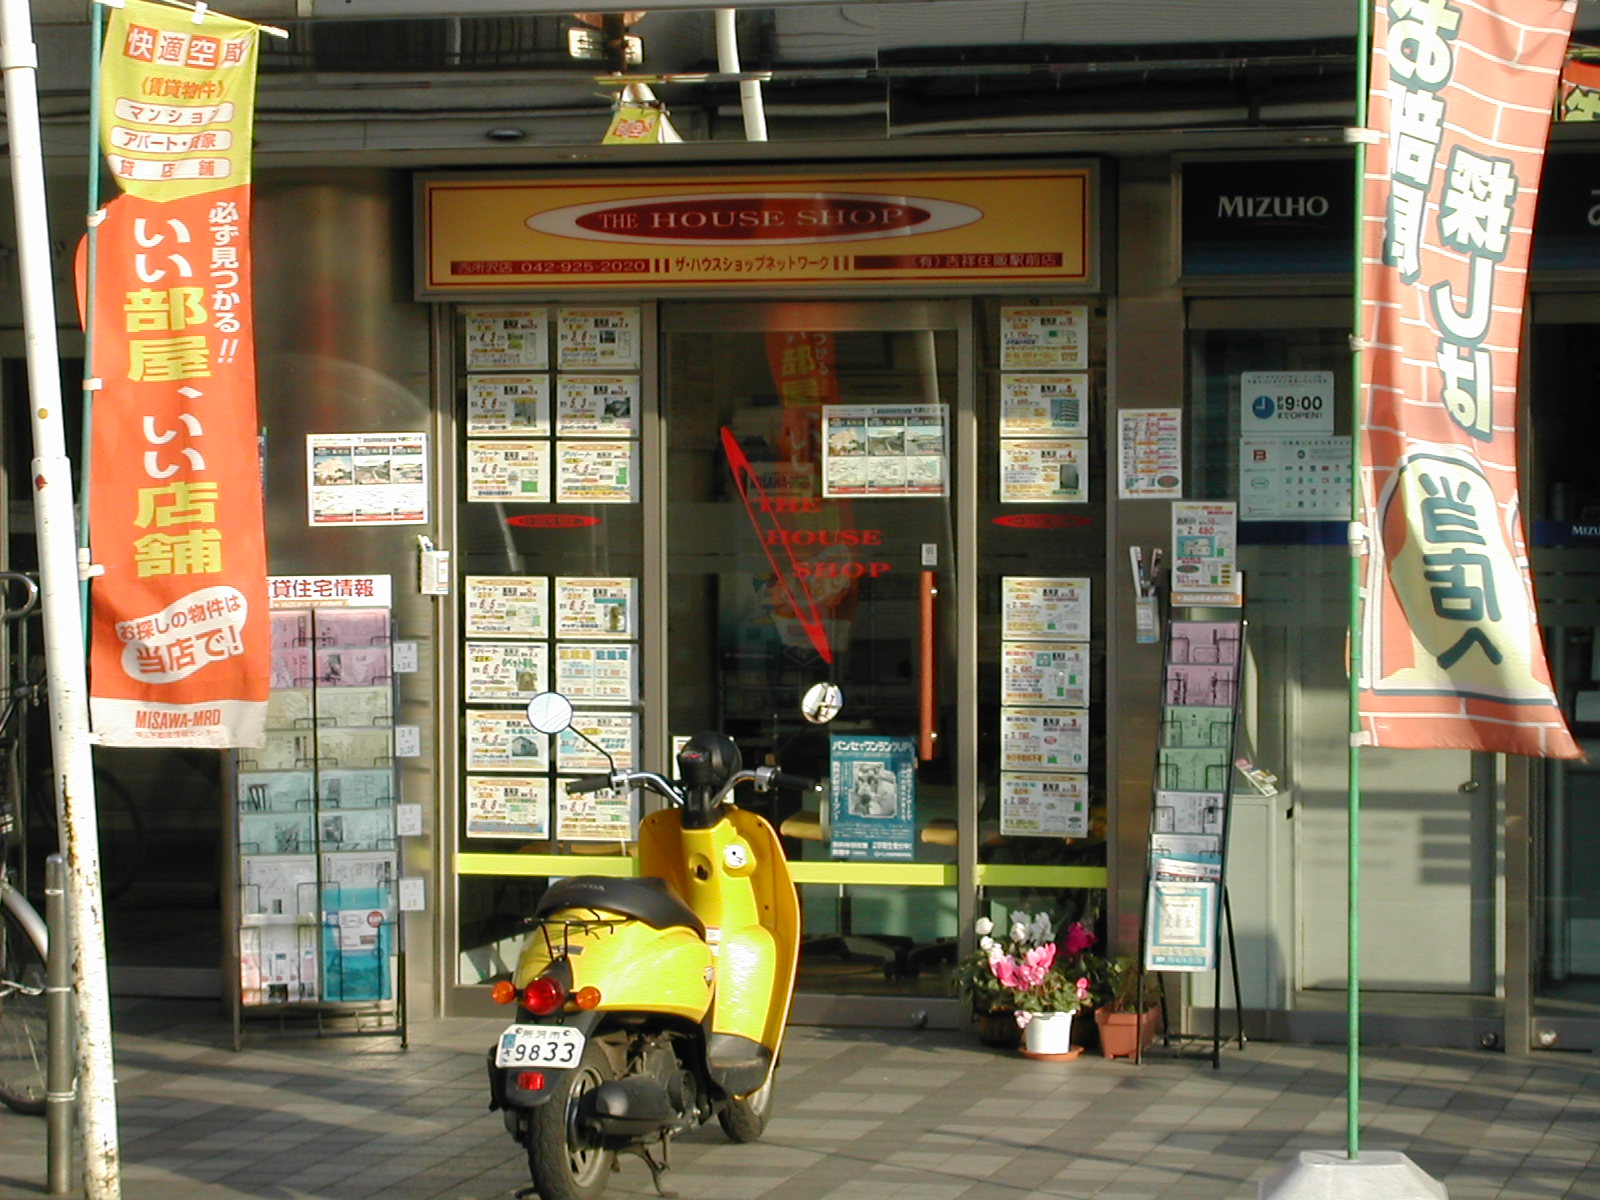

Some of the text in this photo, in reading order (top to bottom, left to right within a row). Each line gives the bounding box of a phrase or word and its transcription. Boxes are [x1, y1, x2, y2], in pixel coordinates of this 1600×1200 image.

[129, 105, 220, 124] マンション
[1218, 196, 1329, 218] MIZUHO
[599, 208, 904, 229] THE HOUSE SHOP
[520, 259, 646, 273] 042-925-2020
[675, 255, 829, 273] ザ・ハウスショップネットワーク
[1285, 396, 1323, 411] 9:00
[754, 497, 823, 513] THE
[765, 529, 884, 546] HOUSE
[791, 562, 892, 579] SHOP
[267, 579, 374, 598] 貸住宅情報
[119, 594, 242, 641] お探しの物件は
[135, 709, 221, 730] MISAWA-MRD
[514, 1041, 575, 1063] 9833
